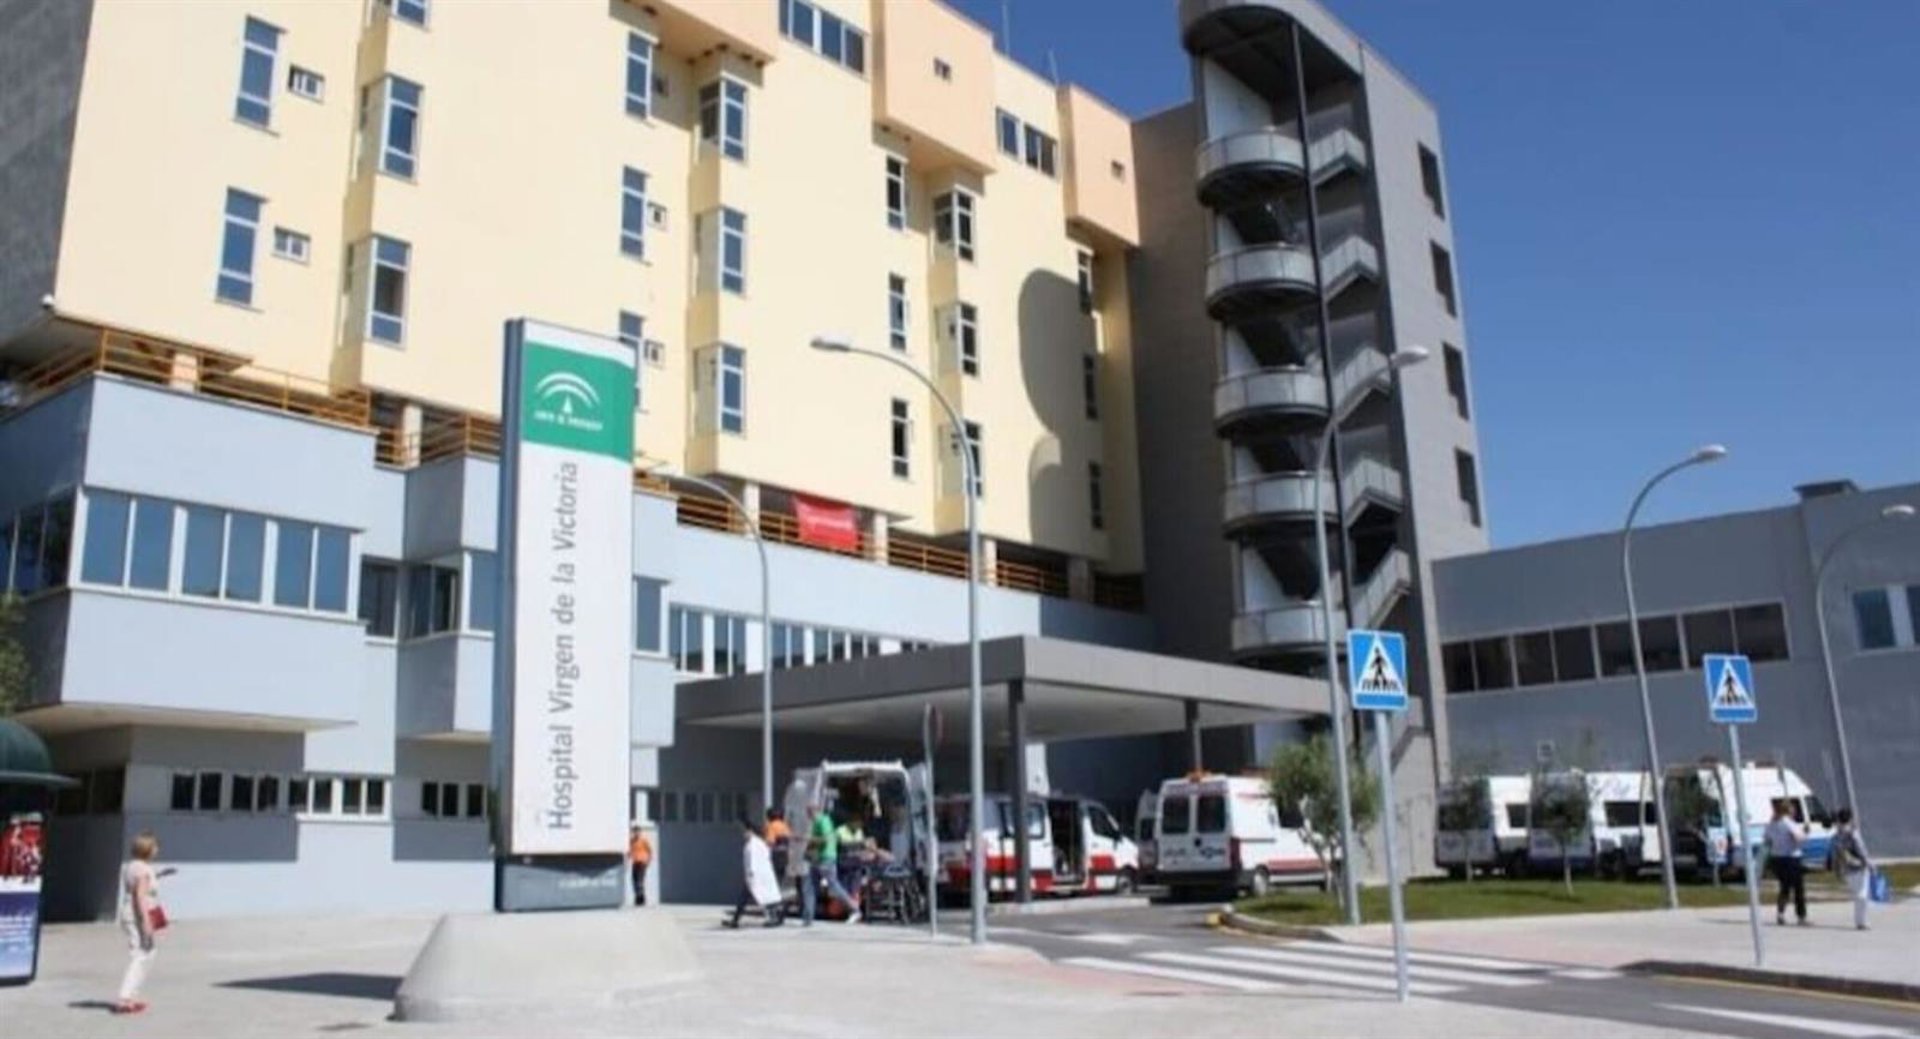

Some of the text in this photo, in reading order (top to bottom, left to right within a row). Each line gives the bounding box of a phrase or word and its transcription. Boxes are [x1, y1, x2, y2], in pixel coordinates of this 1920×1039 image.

[547, 462, 580, 830] Hospital Virgen de la Victoria
